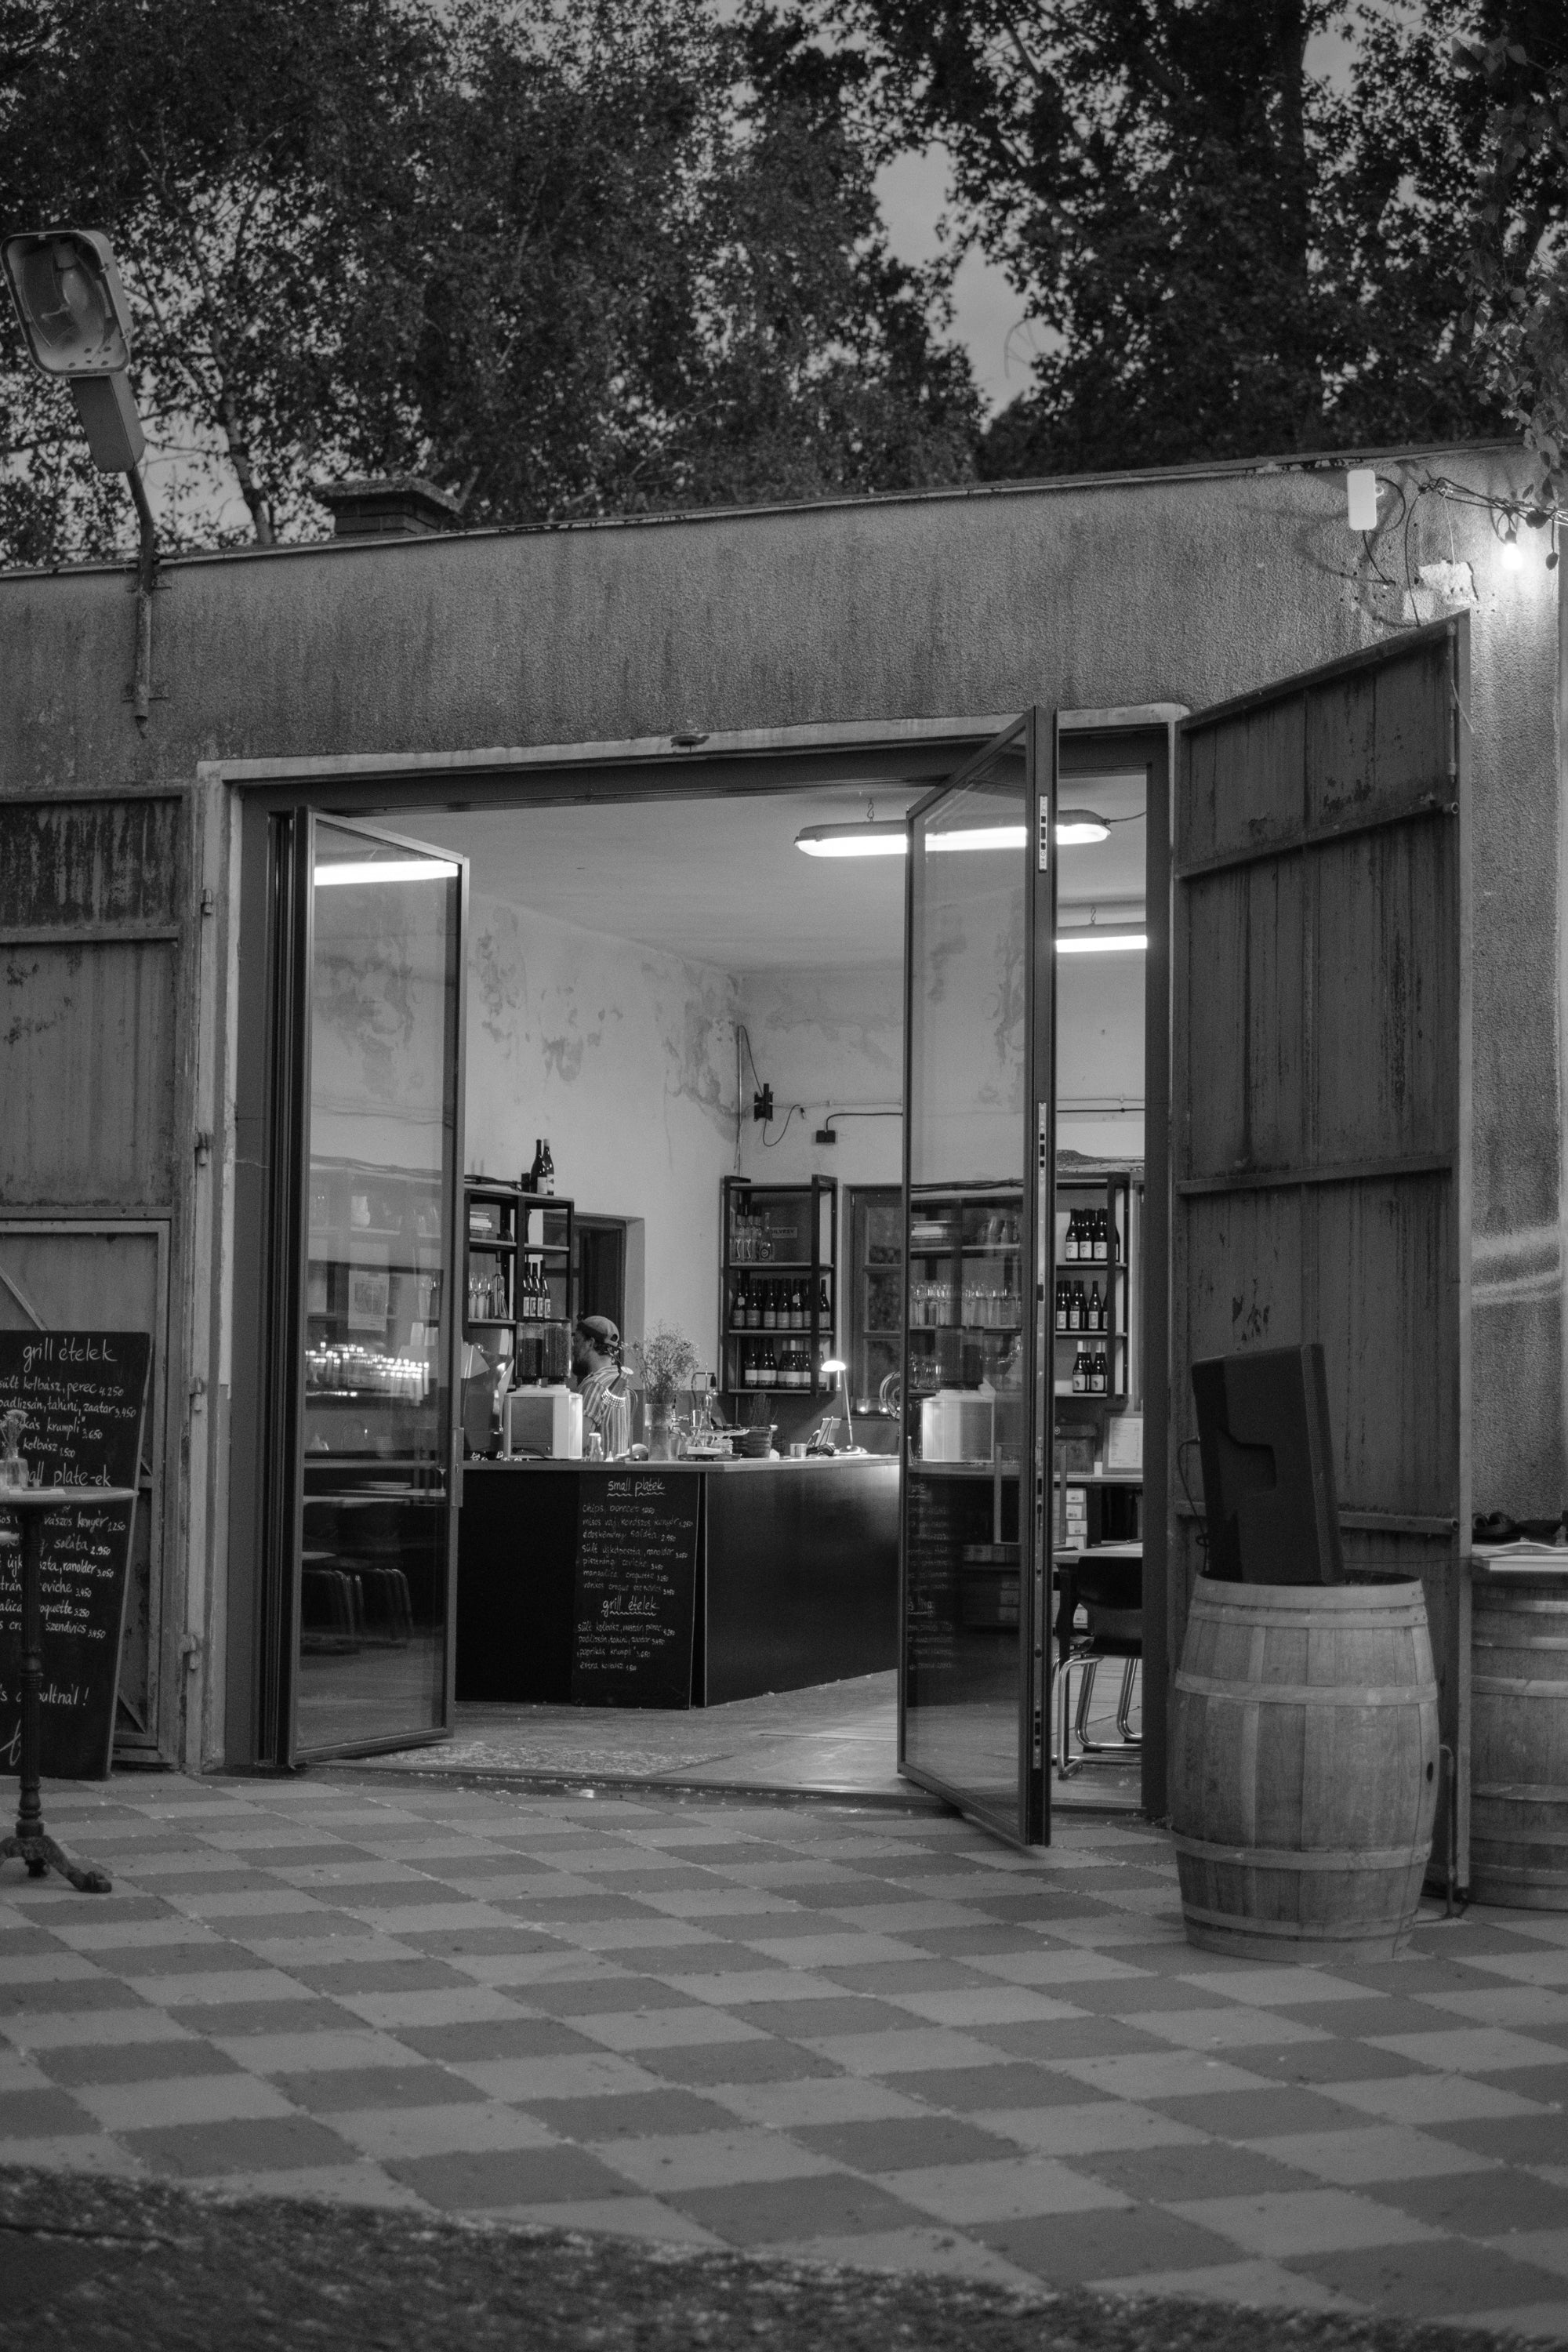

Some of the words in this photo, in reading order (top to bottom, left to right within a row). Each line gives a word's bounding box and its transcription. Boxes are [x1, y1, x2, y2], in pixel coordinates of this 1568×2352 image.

[23, 1337, 53, 1373] grill
[59, 1337, 118, 1362] ételek
[23, 1376, 65, 1394] kolbász,
[67, 1382, 97, 1401] perec
[99, 1386, 125, 1397] 4.250
[47, 1396, 82, 1417] tahini,
[82, 1401, 115, 1414] zaatar
[23, 1436, 58, 1452] kolbász
[28, 1461, 44, 1486] all
[608, 1476, 631, 1492] small
[43, 1513, 73, 1526] vászos
[77, 1510, 110, 1534] kenyér
[53, 1533, 89, 1552] saláta
[90, 1546, 111, 1557] 2.950
[39, 1577, 72, 1593] eviche
[603, 1595, 622, 1617] grill
[628, 1595, 660, 1611] ételek
[45, 1620, 87, 1635] szendvics
[38, 1683, 89, 1706] ultnál!
